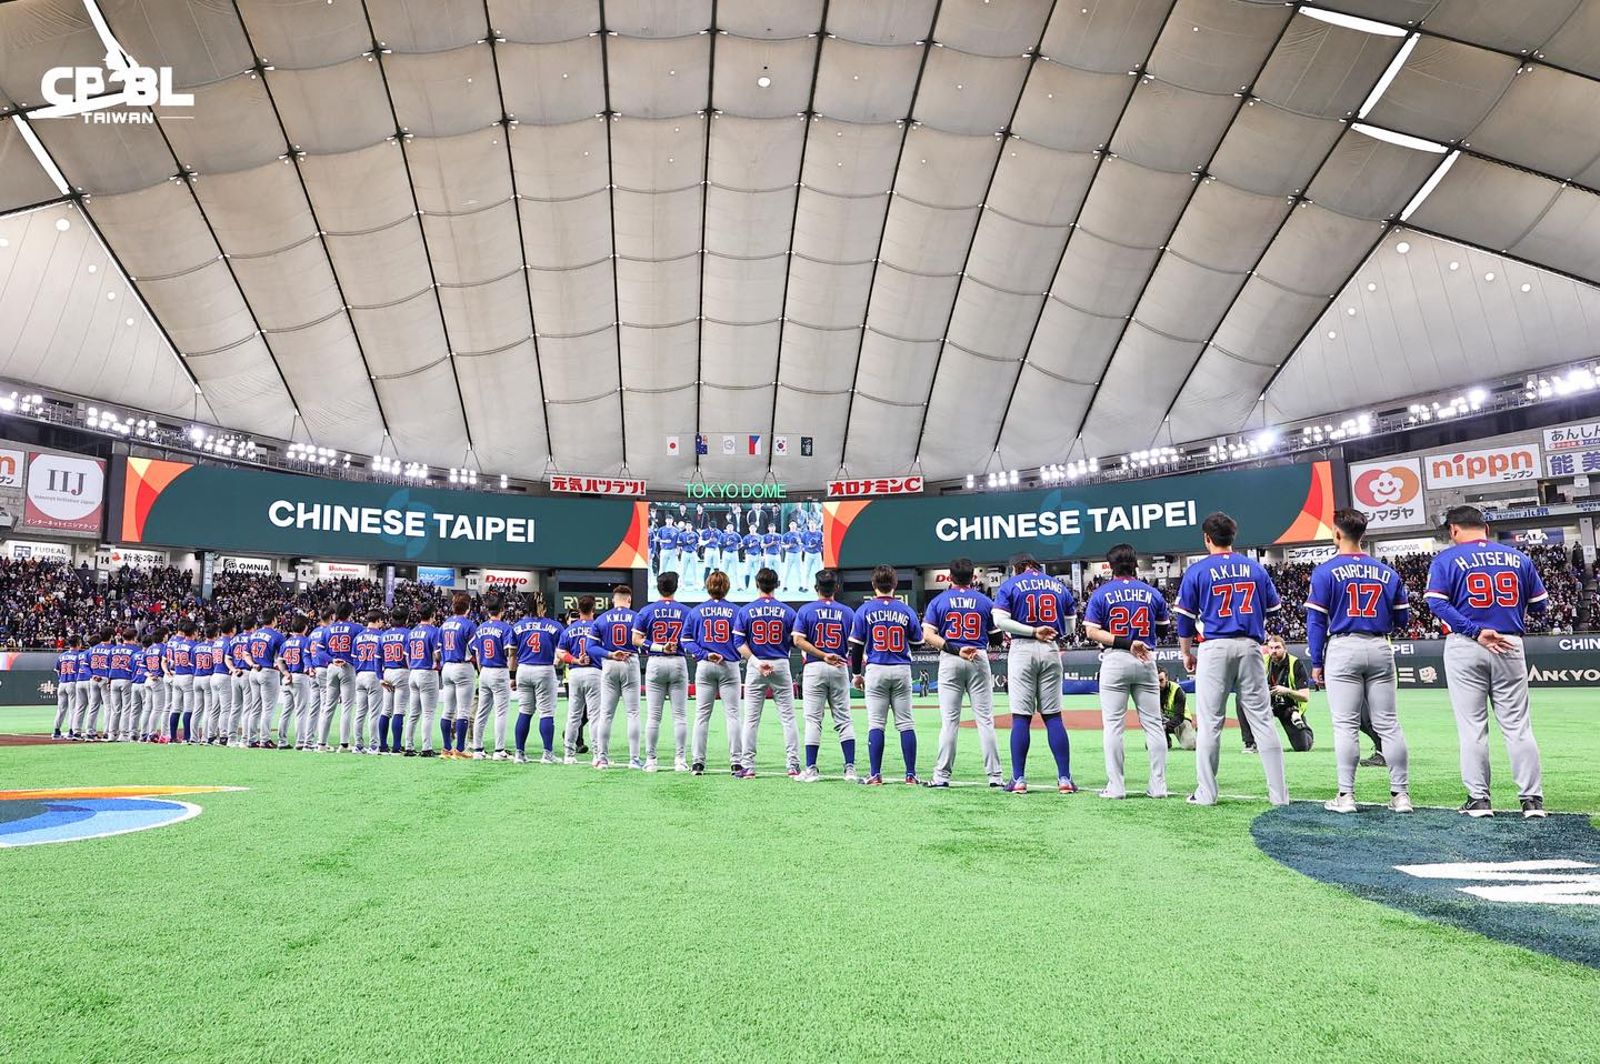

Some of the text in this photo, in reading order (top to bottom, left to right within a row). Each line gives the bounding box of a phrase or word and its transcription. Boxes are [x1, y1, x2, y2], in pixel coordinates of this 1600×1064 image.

[1432, 450, 1533, 480] nippn
[47, 468, 87, 496] IIJ
[1503, 470, 1534, 481] ニップン
[684, 483, 787, 498] TOKYO DOME
[830, 477, 921, 495] オロナミンC
[268, 500, 535, 543] CHINESE TAIPEI
[935, 499, 1197, 542] CHINESE TAIPEI
[100, 556, 109, 564] 14
[239, 562, 270, 572] OMNIA
[1454, 551, 1521, 572] H.J.TSENG
[1209, 563, 1250, 582] A.K.LIN
[1331, 564, 1391, 584] FAIRCHILD
[1015, 579, 1062, 594] Y.C.CHANG
[1105, 588, 1153, 605] C.H.CHEN
[1466, 571, 1520, 609] 99
[563, 596, 609, 610] RYBI
[1026, 593, 1057, 623] 18
[1212, 581, 1256, 618] 77
[1346, 582, 1383, 618] 17
[606, 613, 633, 623] K.W.LIN
[654, 608, 682, 619] C.C.LIN
[700, 607, 733, 618] Y.CHANG
[748, 606, 786, 619] C.W.CHEN
[865, 610, 909, 626] K.Y.CHIANG
[1109, 606, 1150, 637] 24
[612, 623, 627, 646] 0
[652, 621, 683, 644] 27
[703, 619, 730, 643] 19
[752, 620, 783, 645] 98
[814, 622, 842, 649] 15
[945, 611, 982, 641] 39
[328, 634, 351, 653] 42
[483, 638, 495, 659] 9
[527, 632, 541, 653] 4
[872, 625, 905, 653] 90
[251, 641, 267, 658] 47
[282, 647, 301, 665] 45
[357, 642, 376, 662] 37
[383, 642, 404, 662] 20
[410, 640, 425, 660] 12
[111, 654, 131, 670] 23
